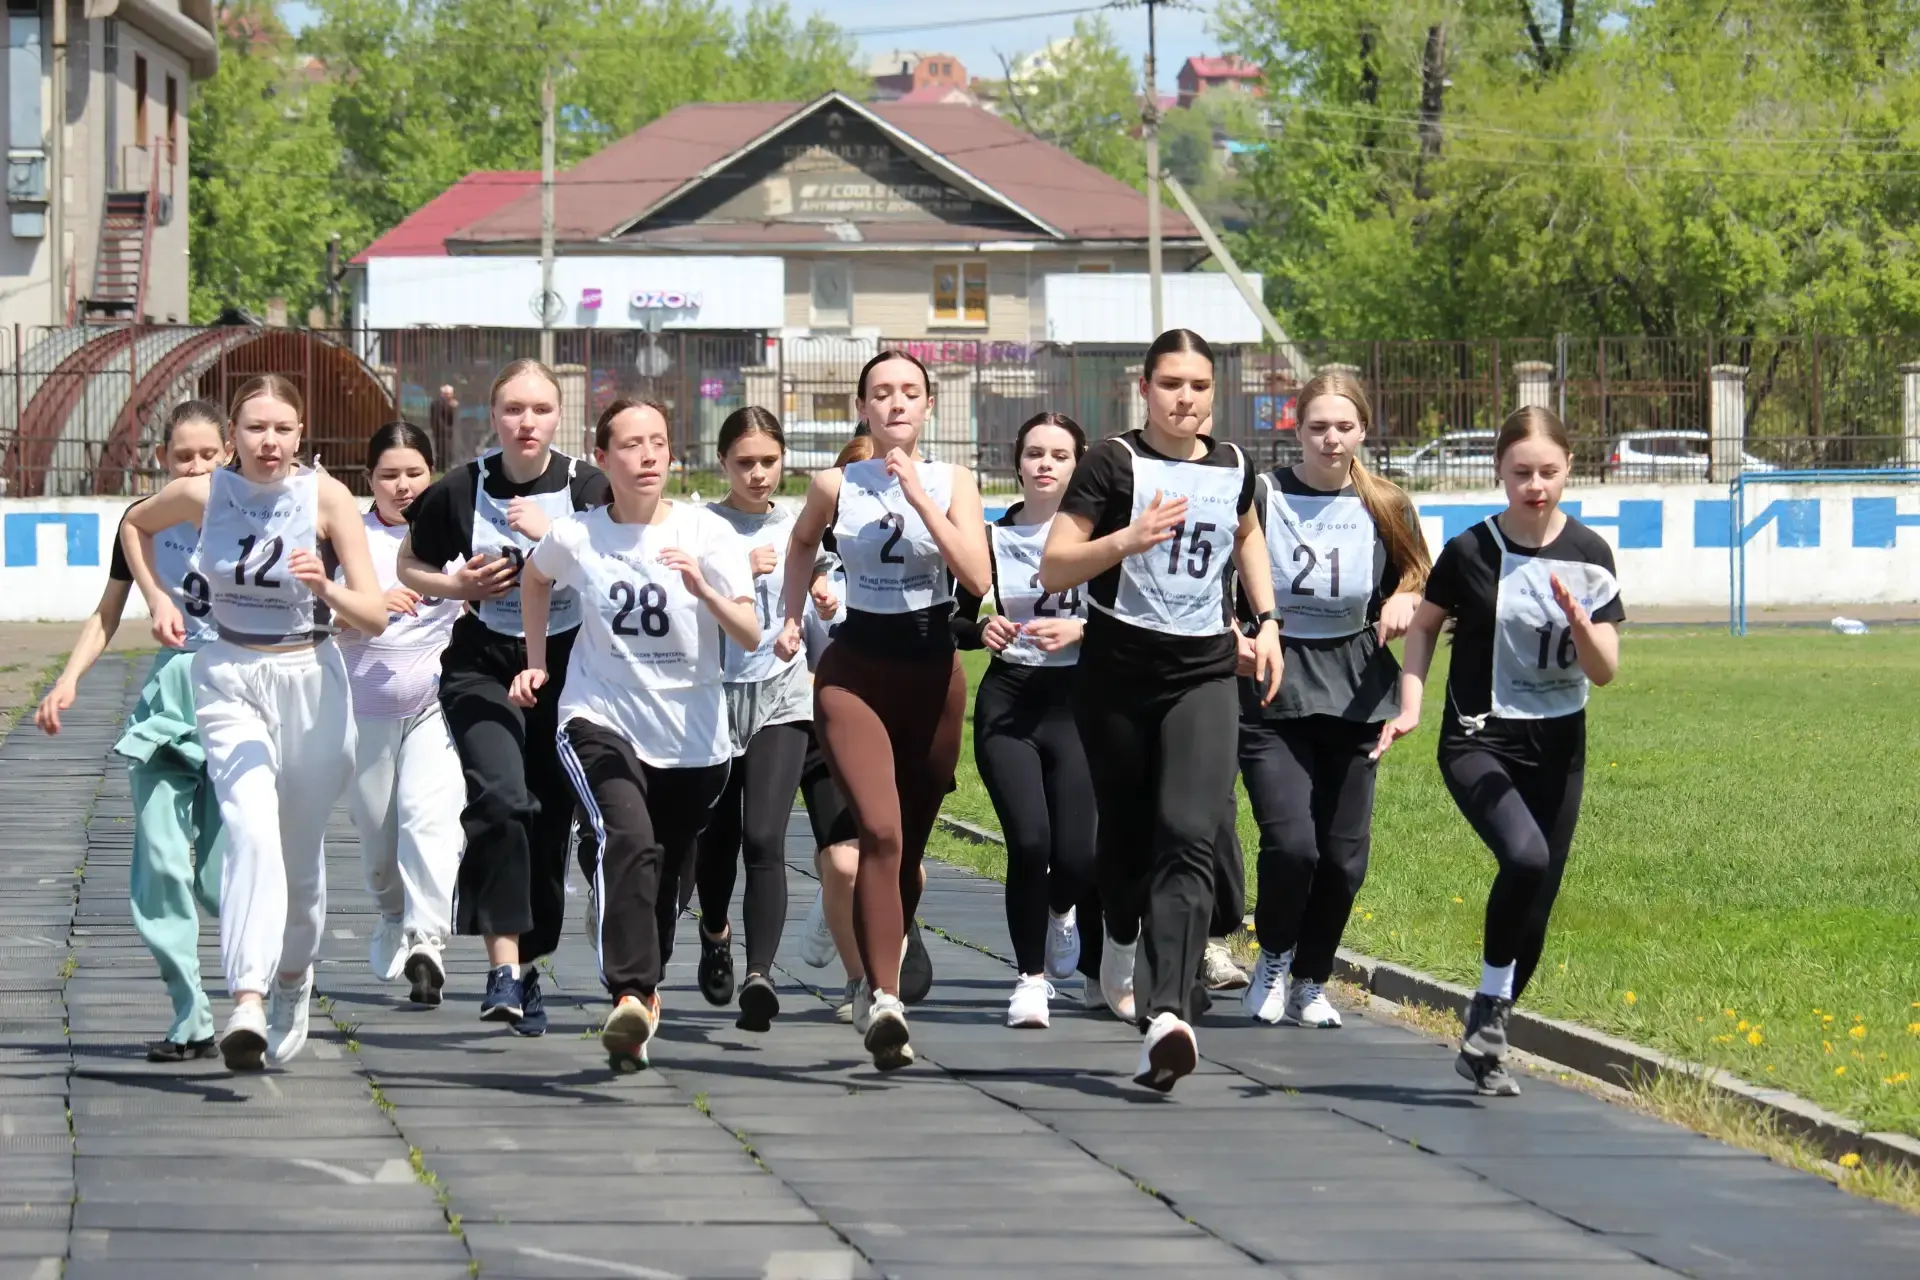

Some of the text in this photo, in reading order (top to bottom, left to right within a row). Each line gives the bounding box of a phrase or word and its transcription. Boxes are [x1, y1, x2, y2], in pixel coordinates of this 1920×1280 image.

[631, 289, 702, 309] OZON
[235, 534, 284, 588] 12
[878, 511, 905, 564] 2
[1167, 520, 1217, 579] 15
[1291, 544, 1340, 598] 21
[609, 580, 670, 638] 28
[1535, 620, 1578, 670] 16
